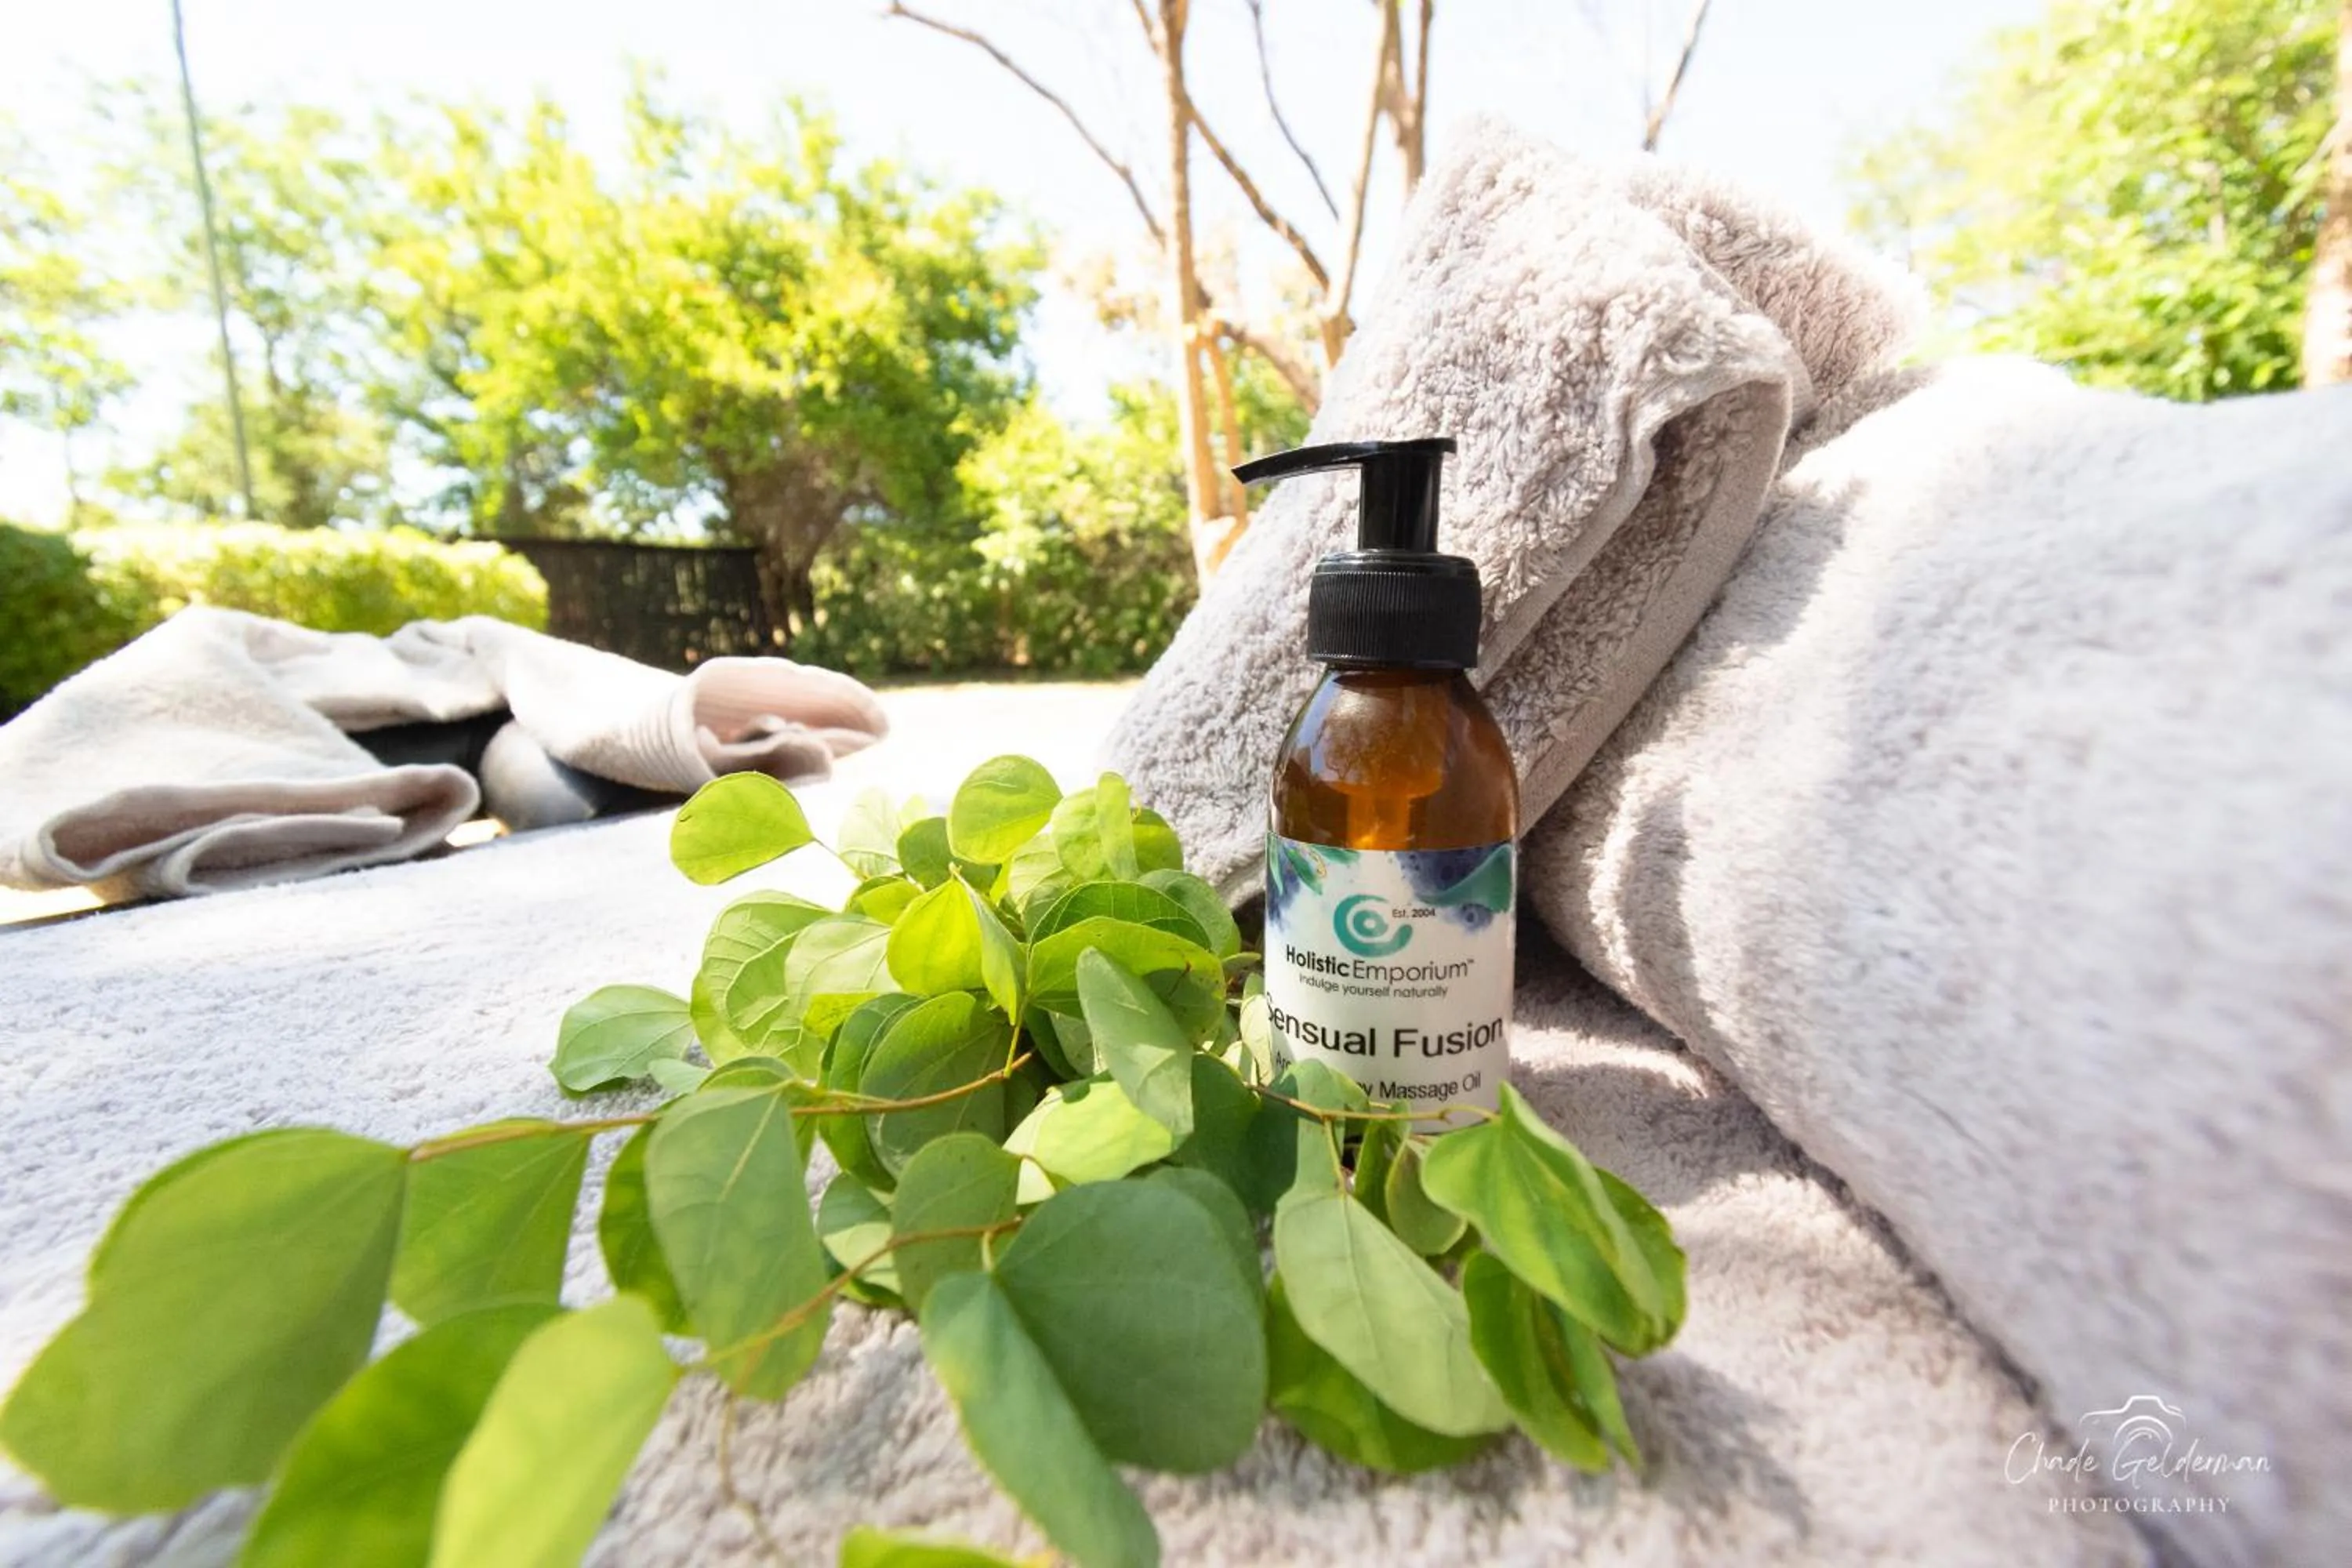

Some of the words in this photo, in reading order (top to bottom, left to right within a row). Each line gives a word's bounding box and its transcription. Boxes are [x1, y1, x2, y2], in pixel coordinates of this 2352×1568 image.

[1411, 908, 1436, 918] 2004
[1342, 983, 1390, 997] yourself
[1393, 985, 1449, 999] naturally
[1393, 1018, 1503, 1058] Fusion
[1379, 1080, 1458, 1102] Massage
[1463, 1072, 1481, 1092] Oil
